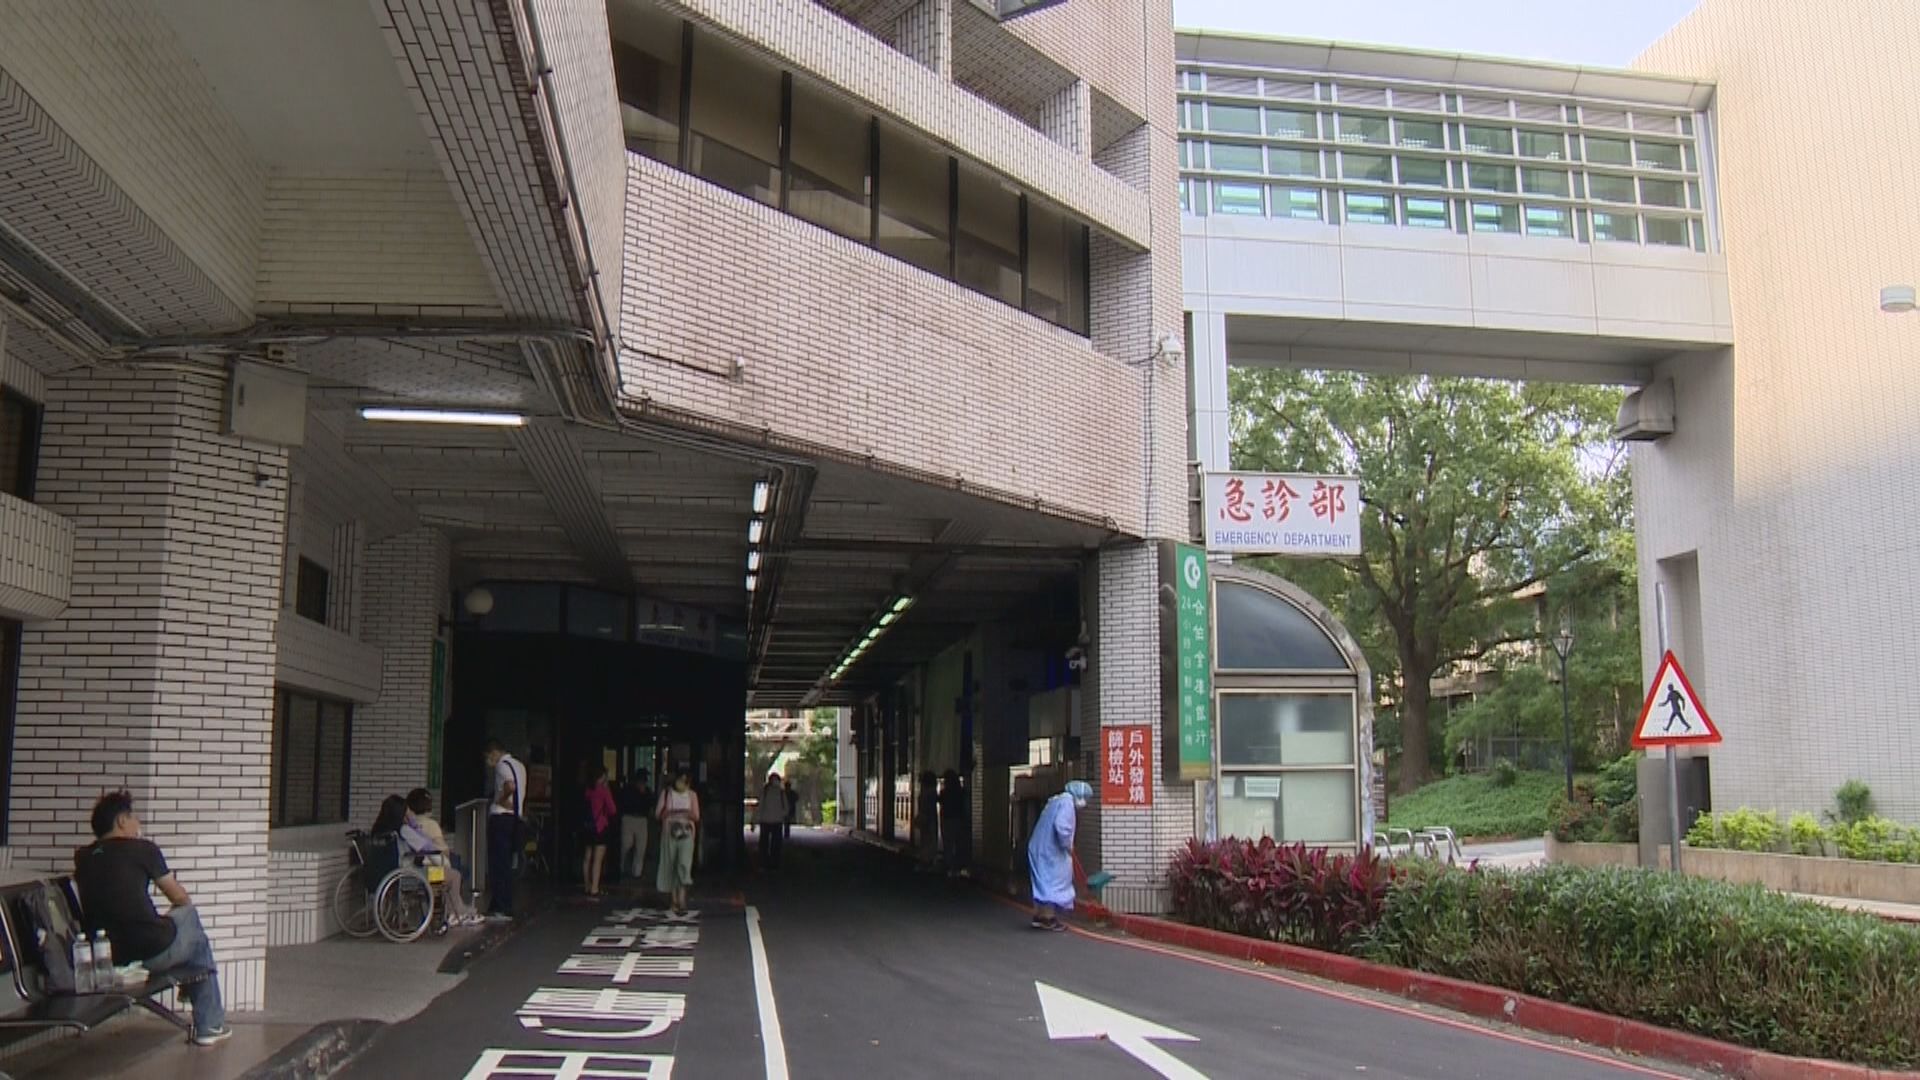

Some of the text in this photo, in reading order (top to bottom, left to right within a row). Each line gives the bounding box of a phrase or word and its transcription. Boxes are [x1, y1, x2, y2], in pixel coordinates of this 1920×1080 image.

[1219, 478, 1346, 523] 急診部
[1215, 531, 1351, 547] EMERGENCY DEPARTMENT
[1108, 730, 1124, 785] 篩檢站
[1128, 730, 1145, 803] 戶外發燒
